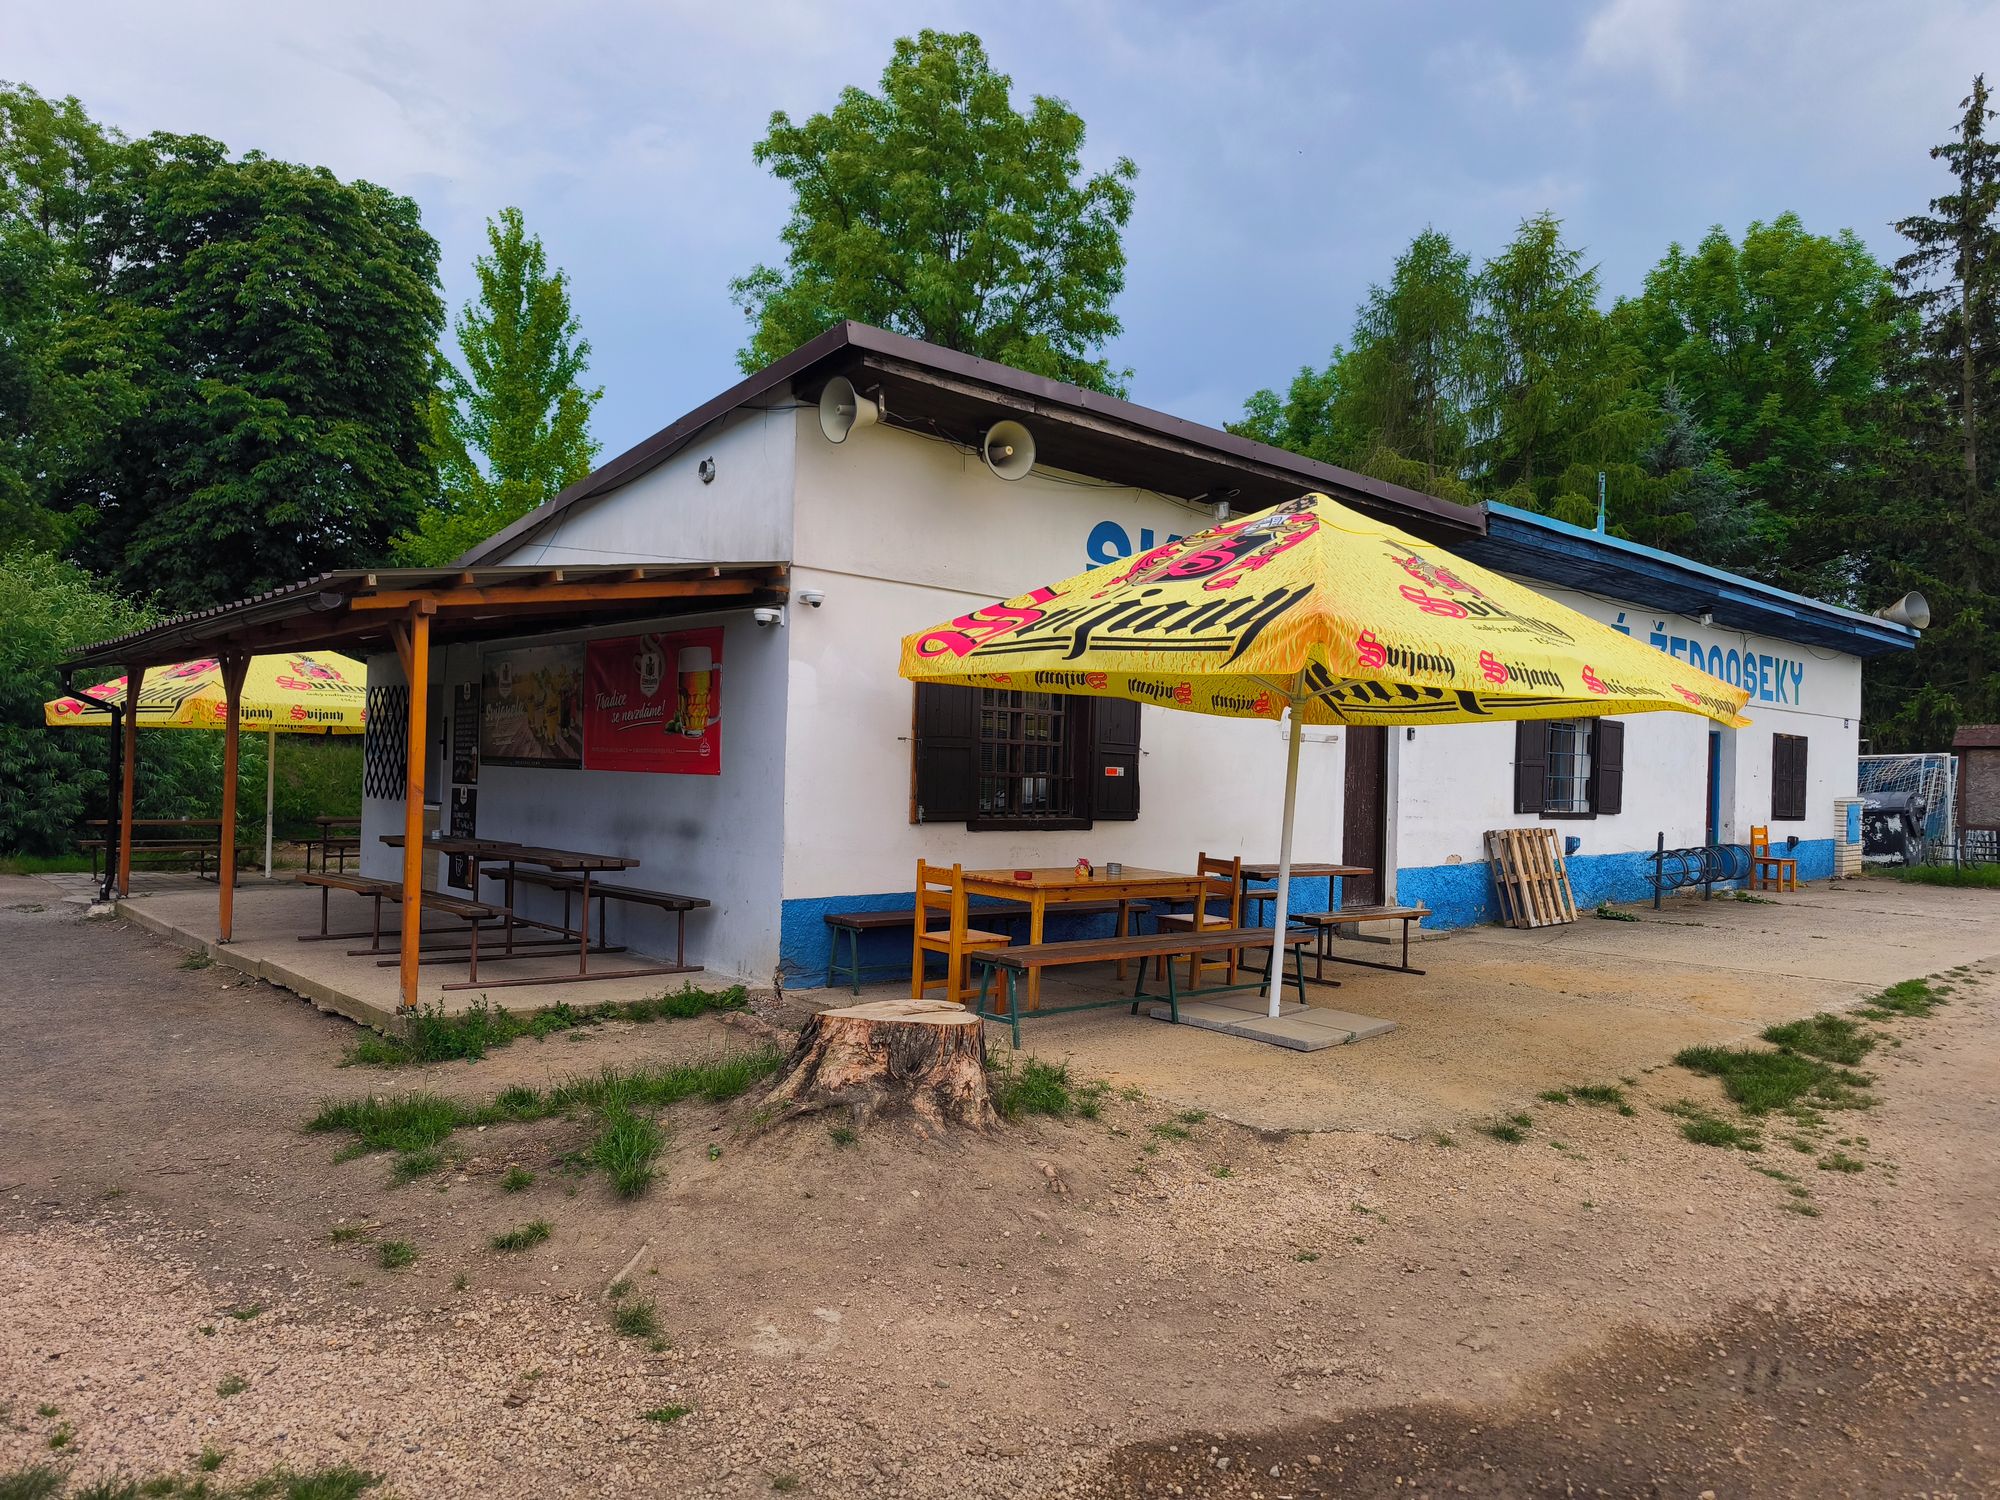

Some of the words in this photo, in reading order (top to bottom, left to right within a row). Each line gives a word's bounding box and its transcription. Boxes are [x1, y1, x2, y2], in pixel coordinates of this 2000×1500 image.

[915, 583, 1316, 668] Svijany
[1356, 628, 1456, 681] Svijany
[1479, 649, 1565, 692] Svijany
[1582, 664, 1666, 698] Svijany
[214, 702, 273, 721] Sijany
[290, 704, 344, 722] Svijany
[595, 689, 627, 712] Tradice
[611, 711, 620, 724] se
[622, 700, 666, 722] nevzdáme!
[1671, 683, 1737, 715] Svijany
